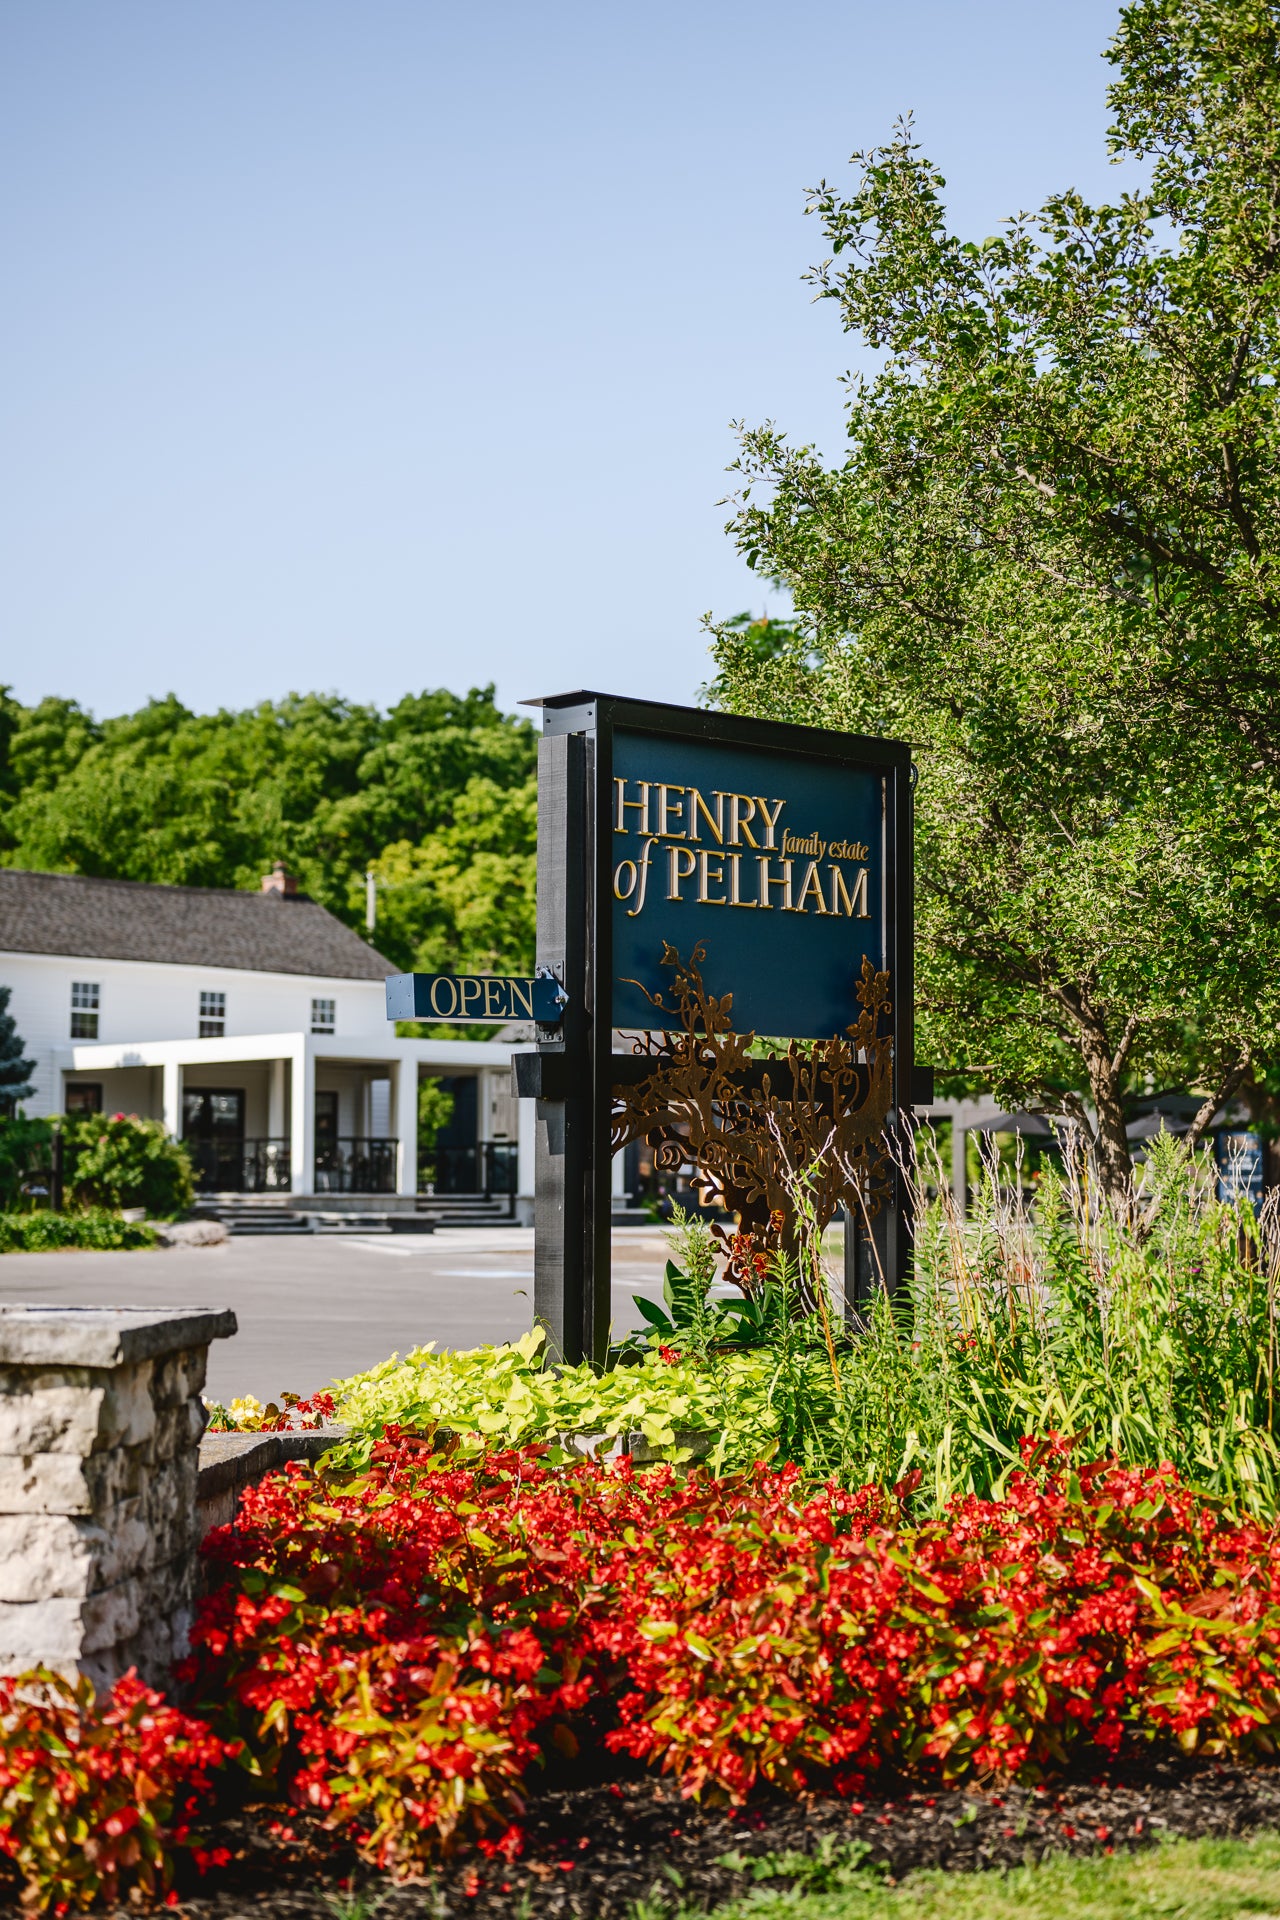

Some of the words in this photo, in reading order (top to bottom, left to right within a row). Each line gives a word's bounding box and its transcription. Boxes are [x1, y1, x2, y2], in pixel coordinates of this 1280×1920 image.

[613, 776, 787, 851] HENRY
[778, 827, 826, 863] family
[828, 842, 870, 861] estate
[613, 837, 659, 917] of
[665, 845, 872, 919] PELHAM
[430, 976, 535, 1018] OPEN
